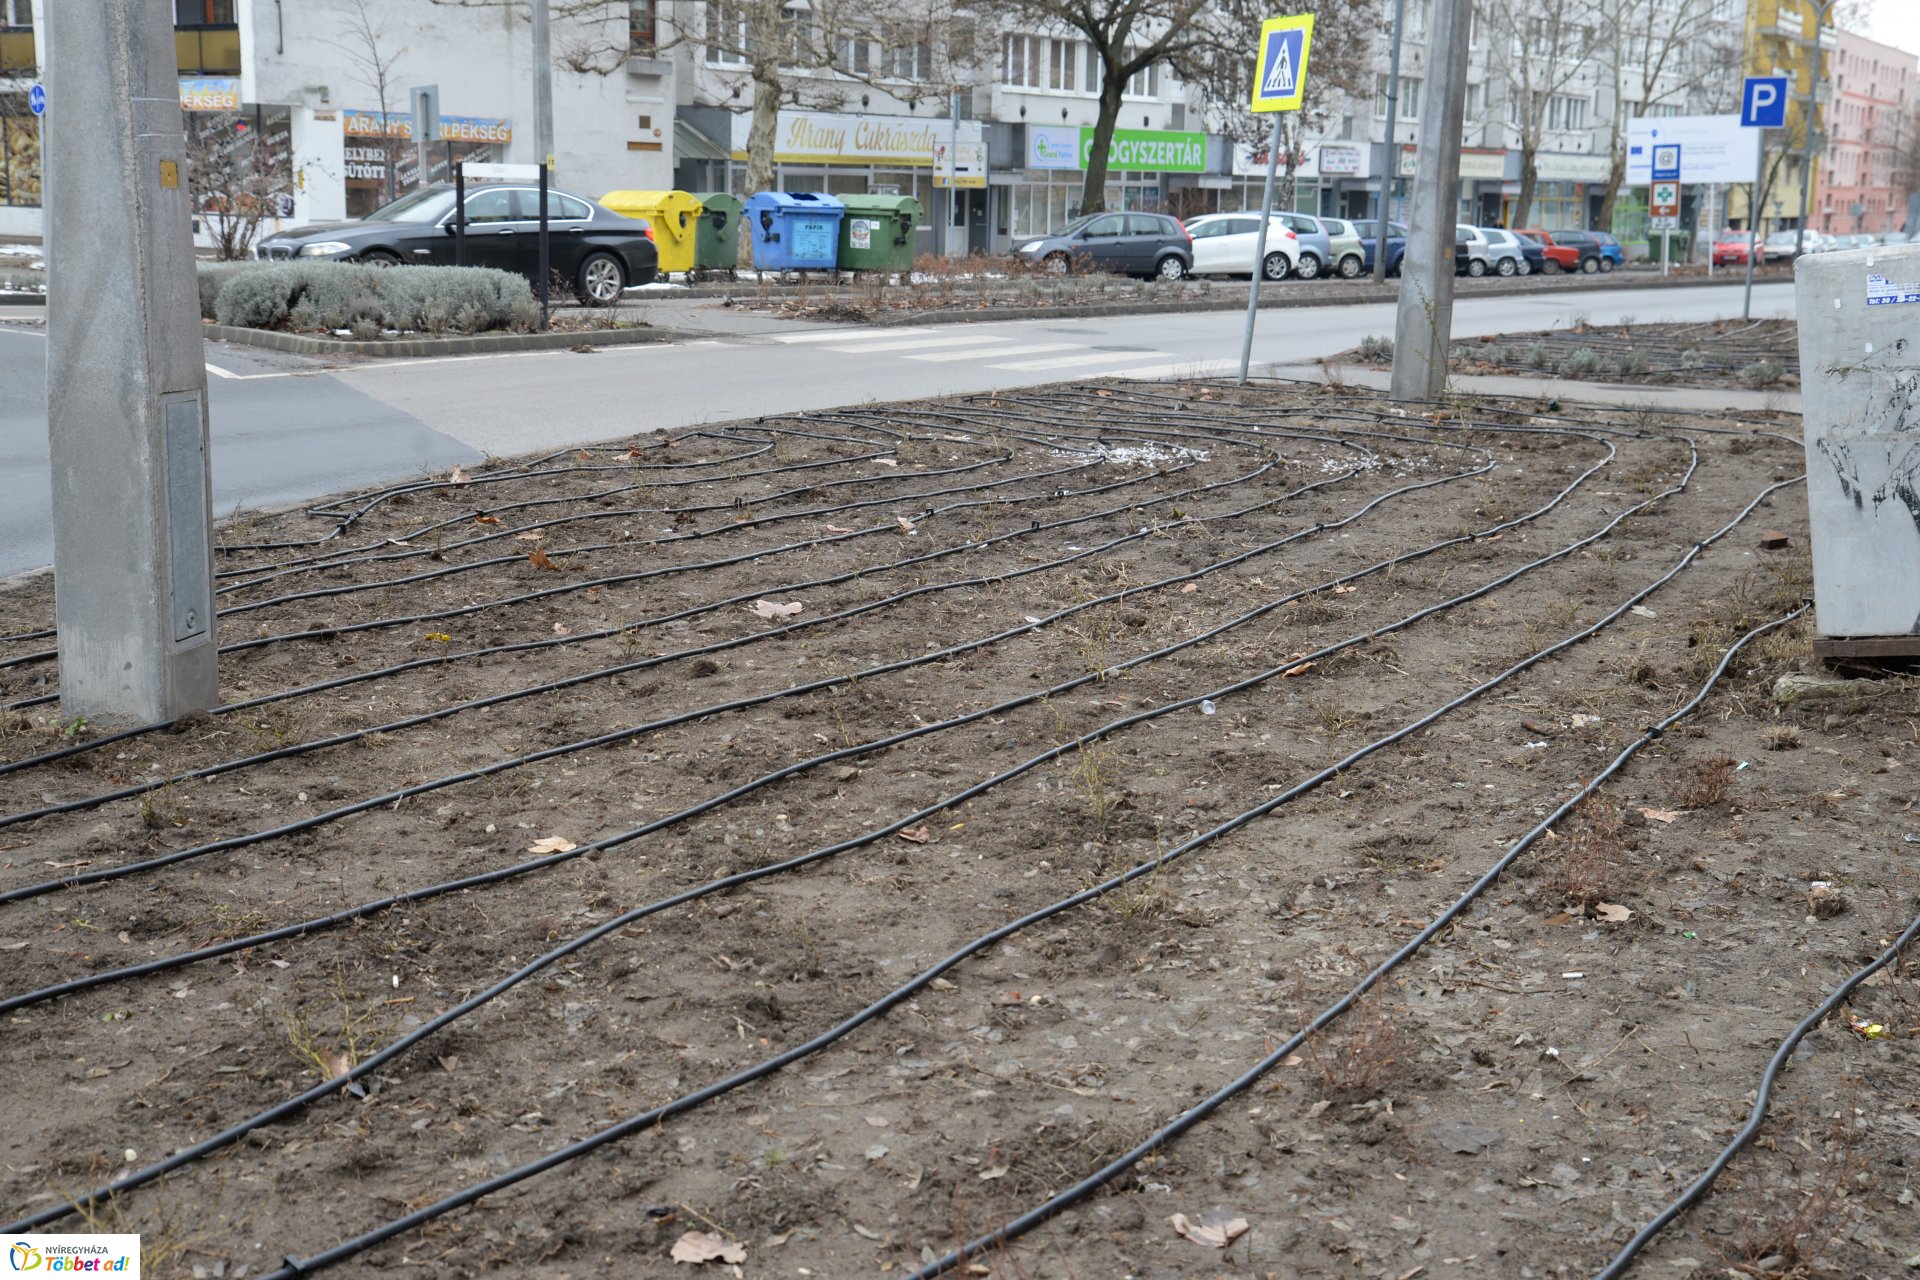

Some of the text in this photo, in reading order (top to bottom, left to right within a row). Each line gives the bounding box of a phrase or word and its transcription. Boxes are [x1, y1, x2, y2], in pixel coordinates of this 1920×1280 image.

[1749, 83, 1778, 123] P
[786, 116, 937, 156] Arany Cukrászda
